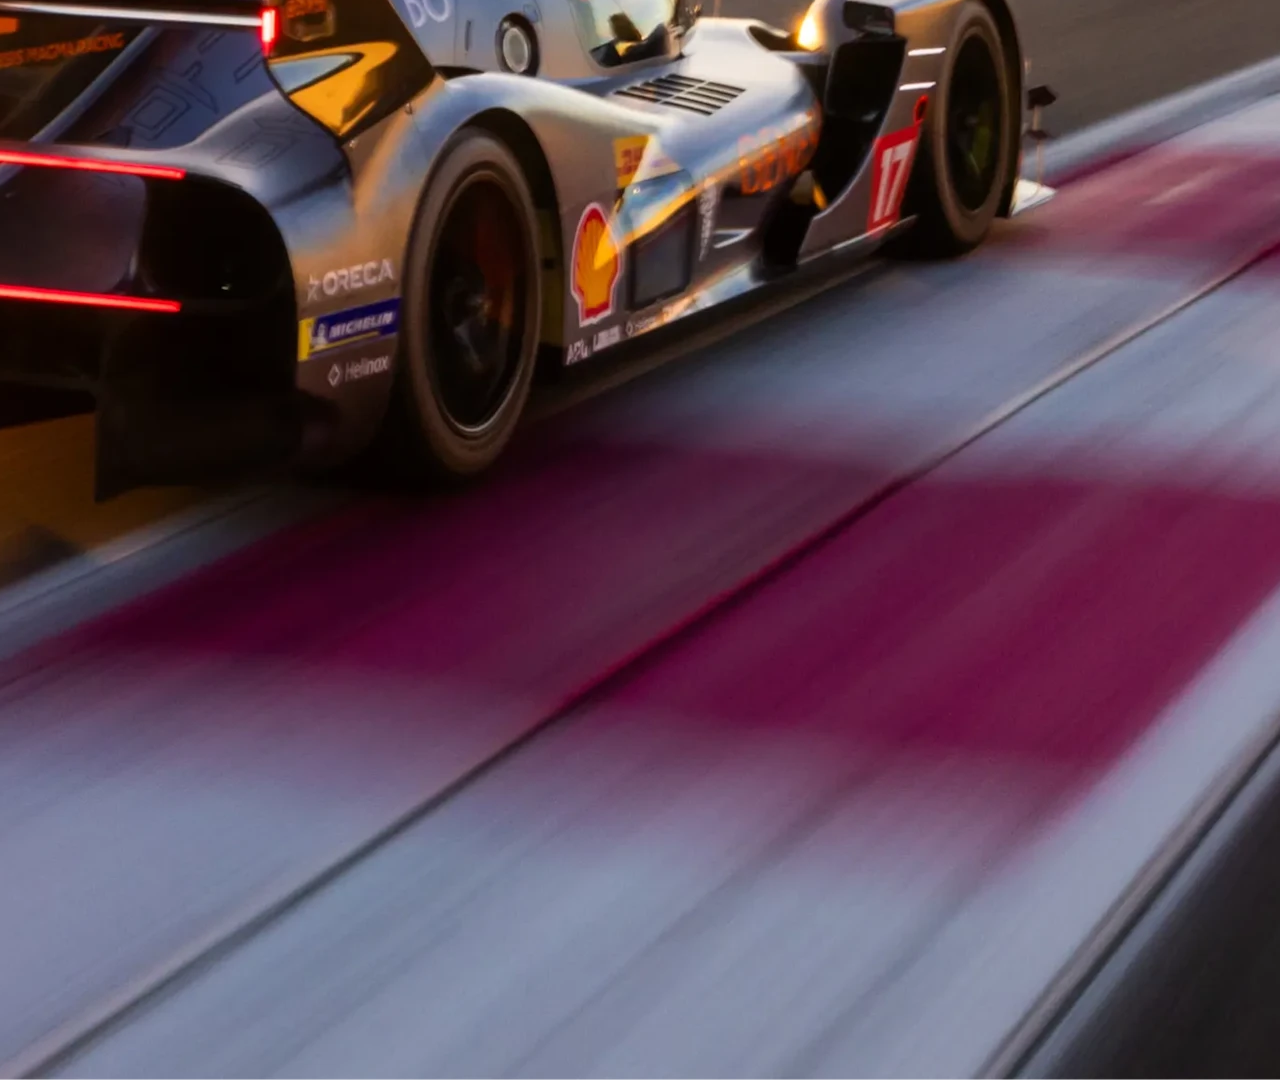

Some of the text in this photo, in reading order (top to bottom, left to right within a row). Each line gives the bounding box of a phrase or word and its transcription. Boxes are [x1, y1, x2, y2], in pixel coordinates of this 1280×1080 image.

[873, 139, 915, 223] 17
[323, 258, 393, 295] ORECA
[329, 311, 394, 338] MICHELIN
[344, 355, 389, 382] Helinox
